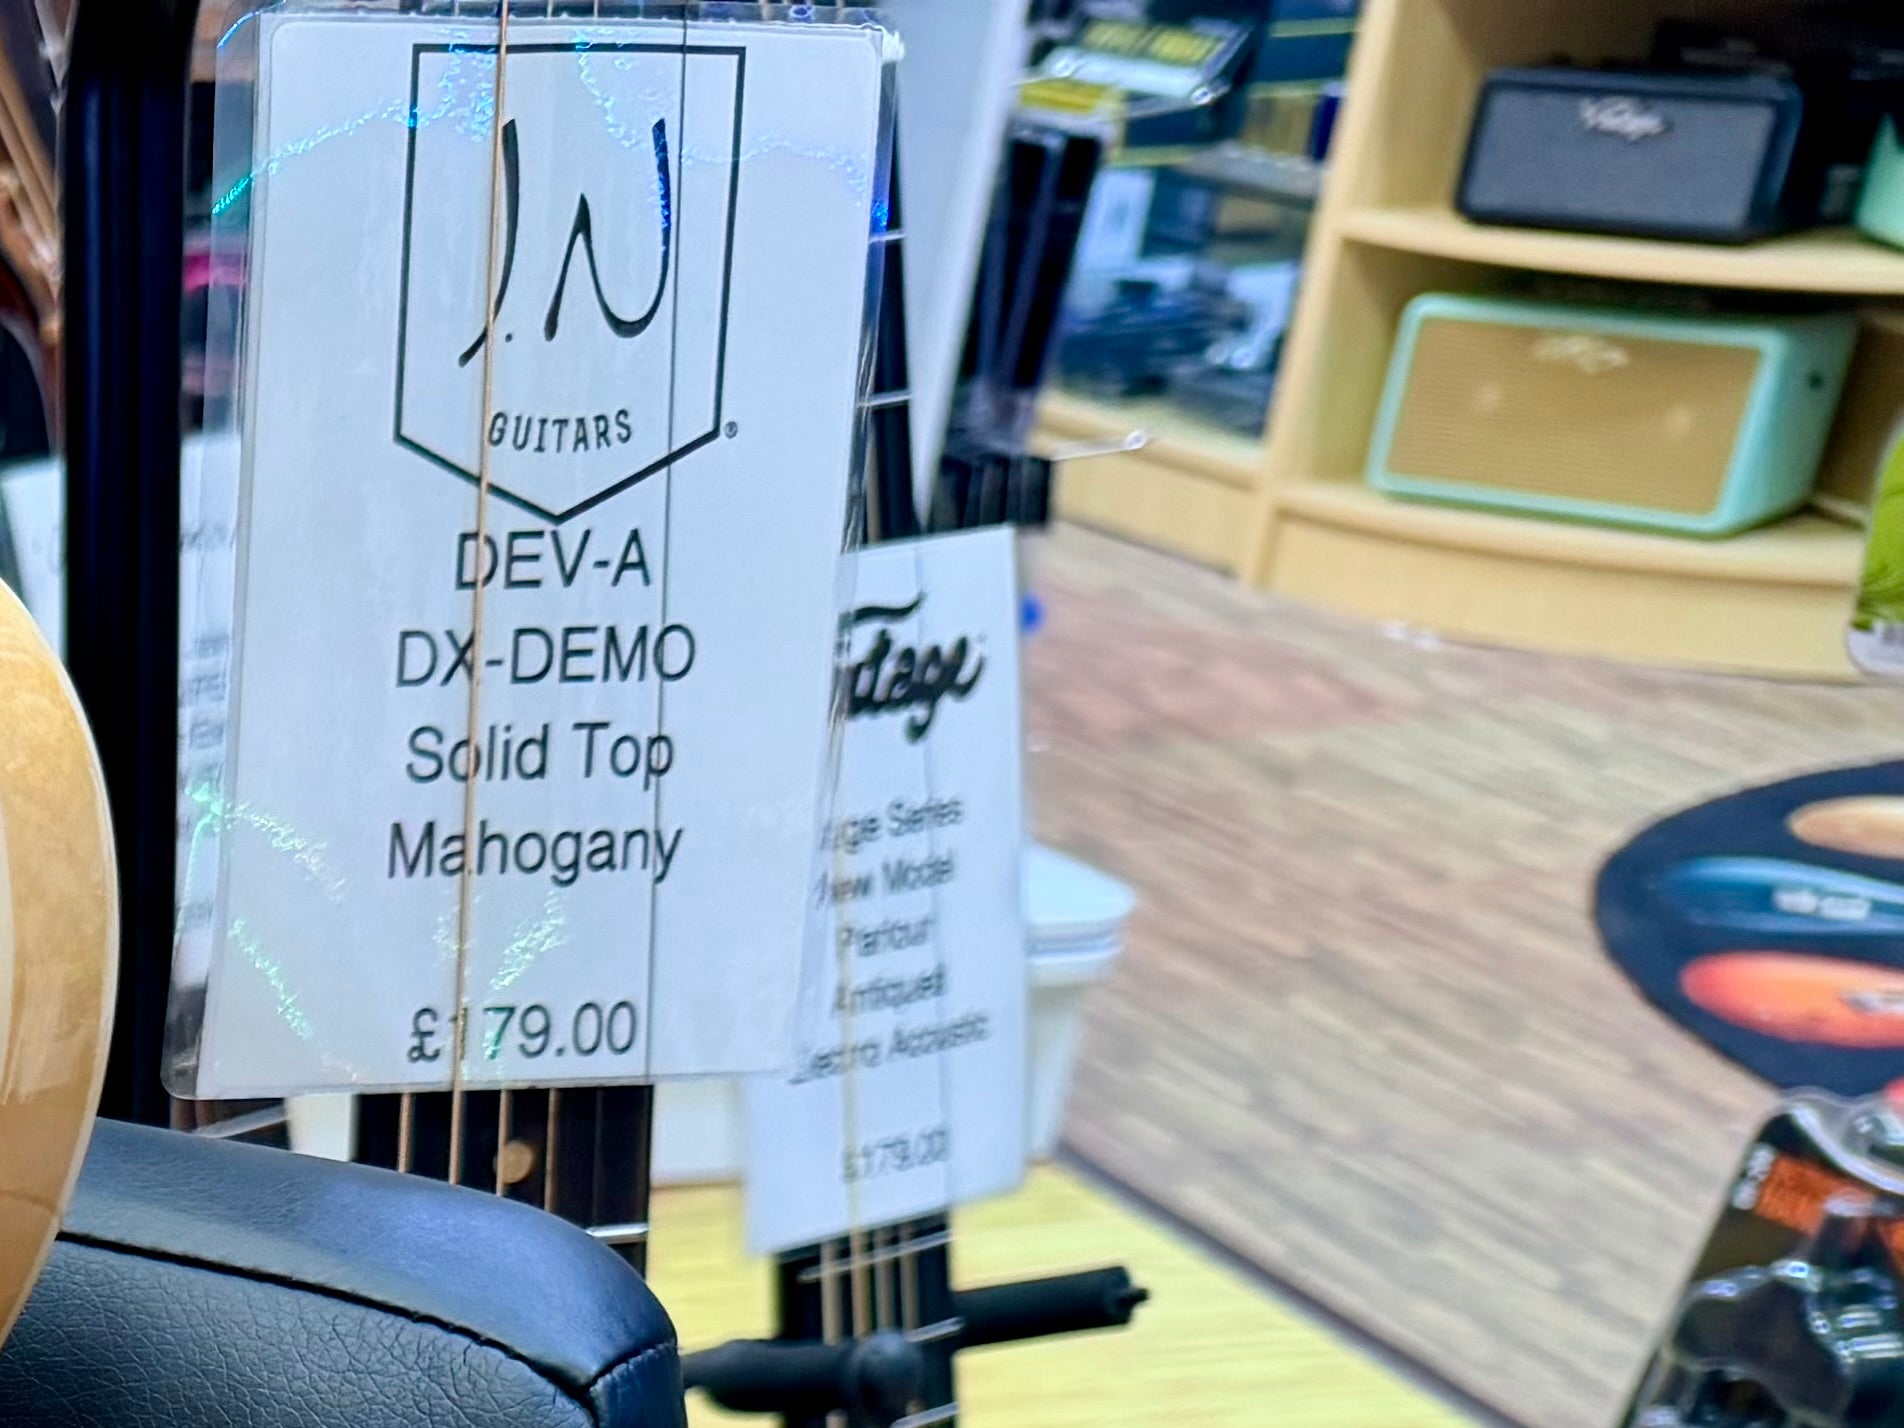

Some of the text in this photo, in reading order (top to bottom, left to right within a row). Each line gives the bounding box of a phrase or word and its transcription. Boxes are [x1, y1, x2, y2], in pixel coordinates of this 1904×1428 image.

[488, 408, 633, 453] GUITARS
[455, 527, 651, 591] DEV-A
[395, 623, 697, 688] DX-DEMO
[405, 721, 674, 793] Solid Top
[387, 818, 684, 889] Mahogany
